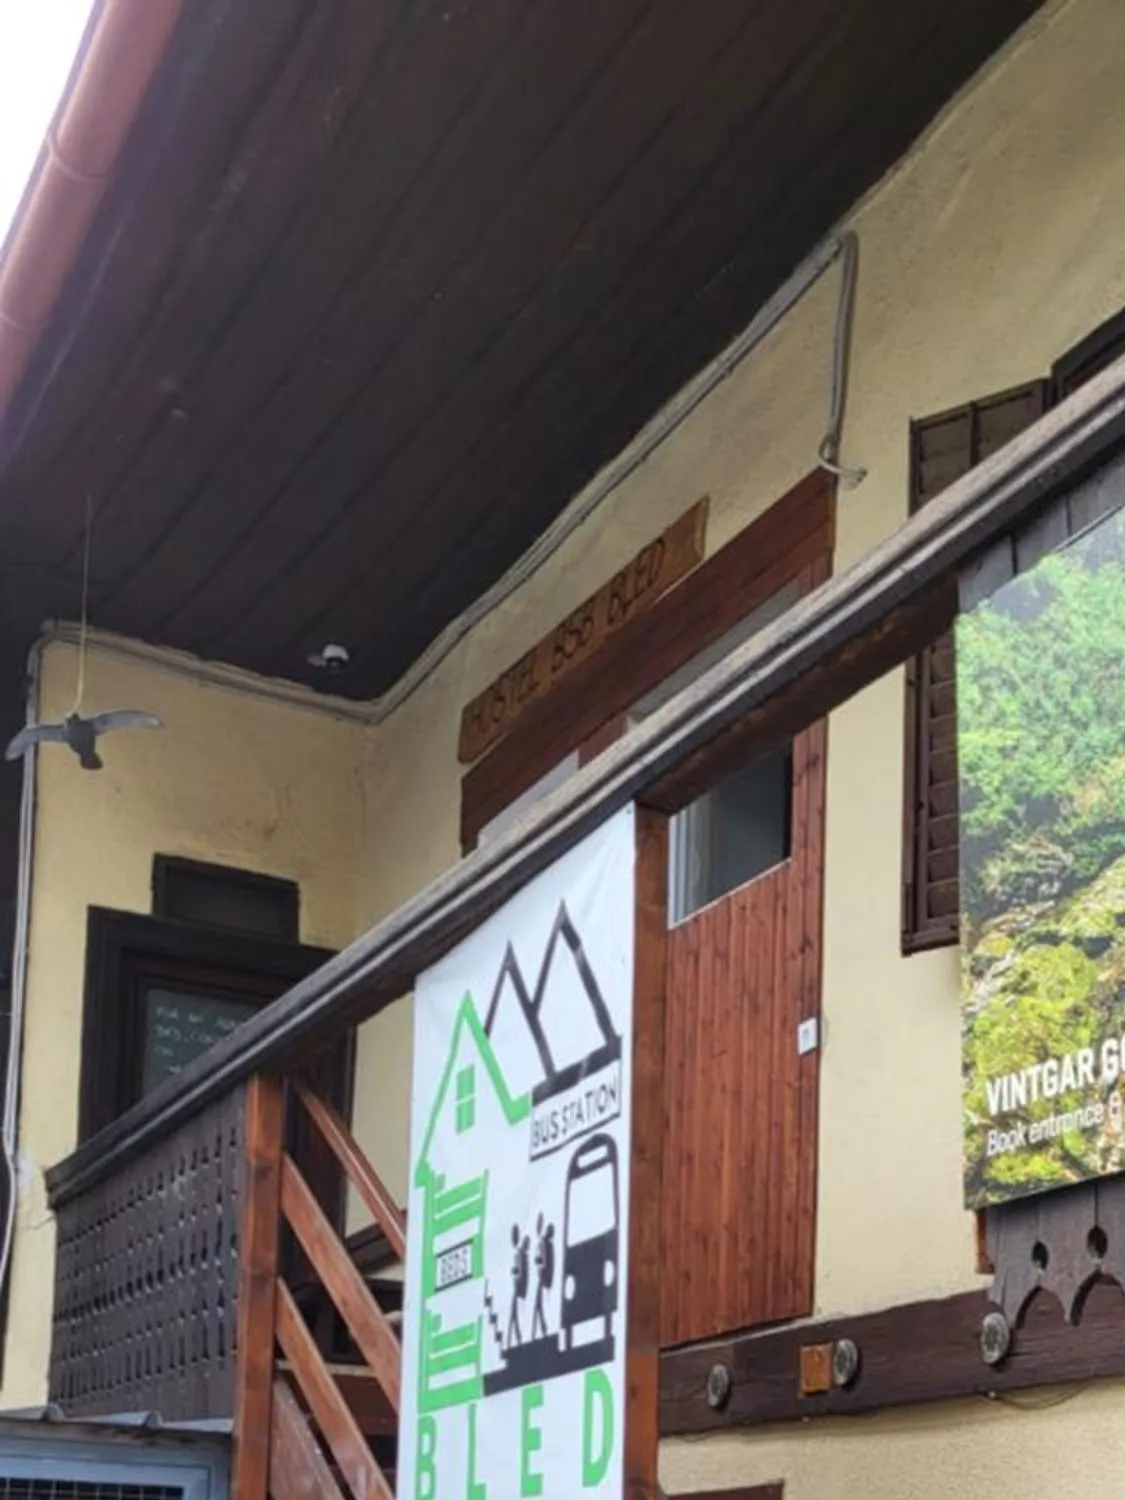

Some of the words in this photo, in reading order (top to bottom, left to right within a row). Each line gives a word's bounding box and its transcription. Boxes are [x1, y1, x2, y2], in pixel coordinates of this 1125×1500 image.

[531, 1110, 559, 1149] BUS
[561, 1075, 618, 1136] STATION
[986, 1047, 1095, 1115] VINTGAR
[986, 1122, 1027, 1157] Book
[1029, 1102, 1104, 1145] entrance
